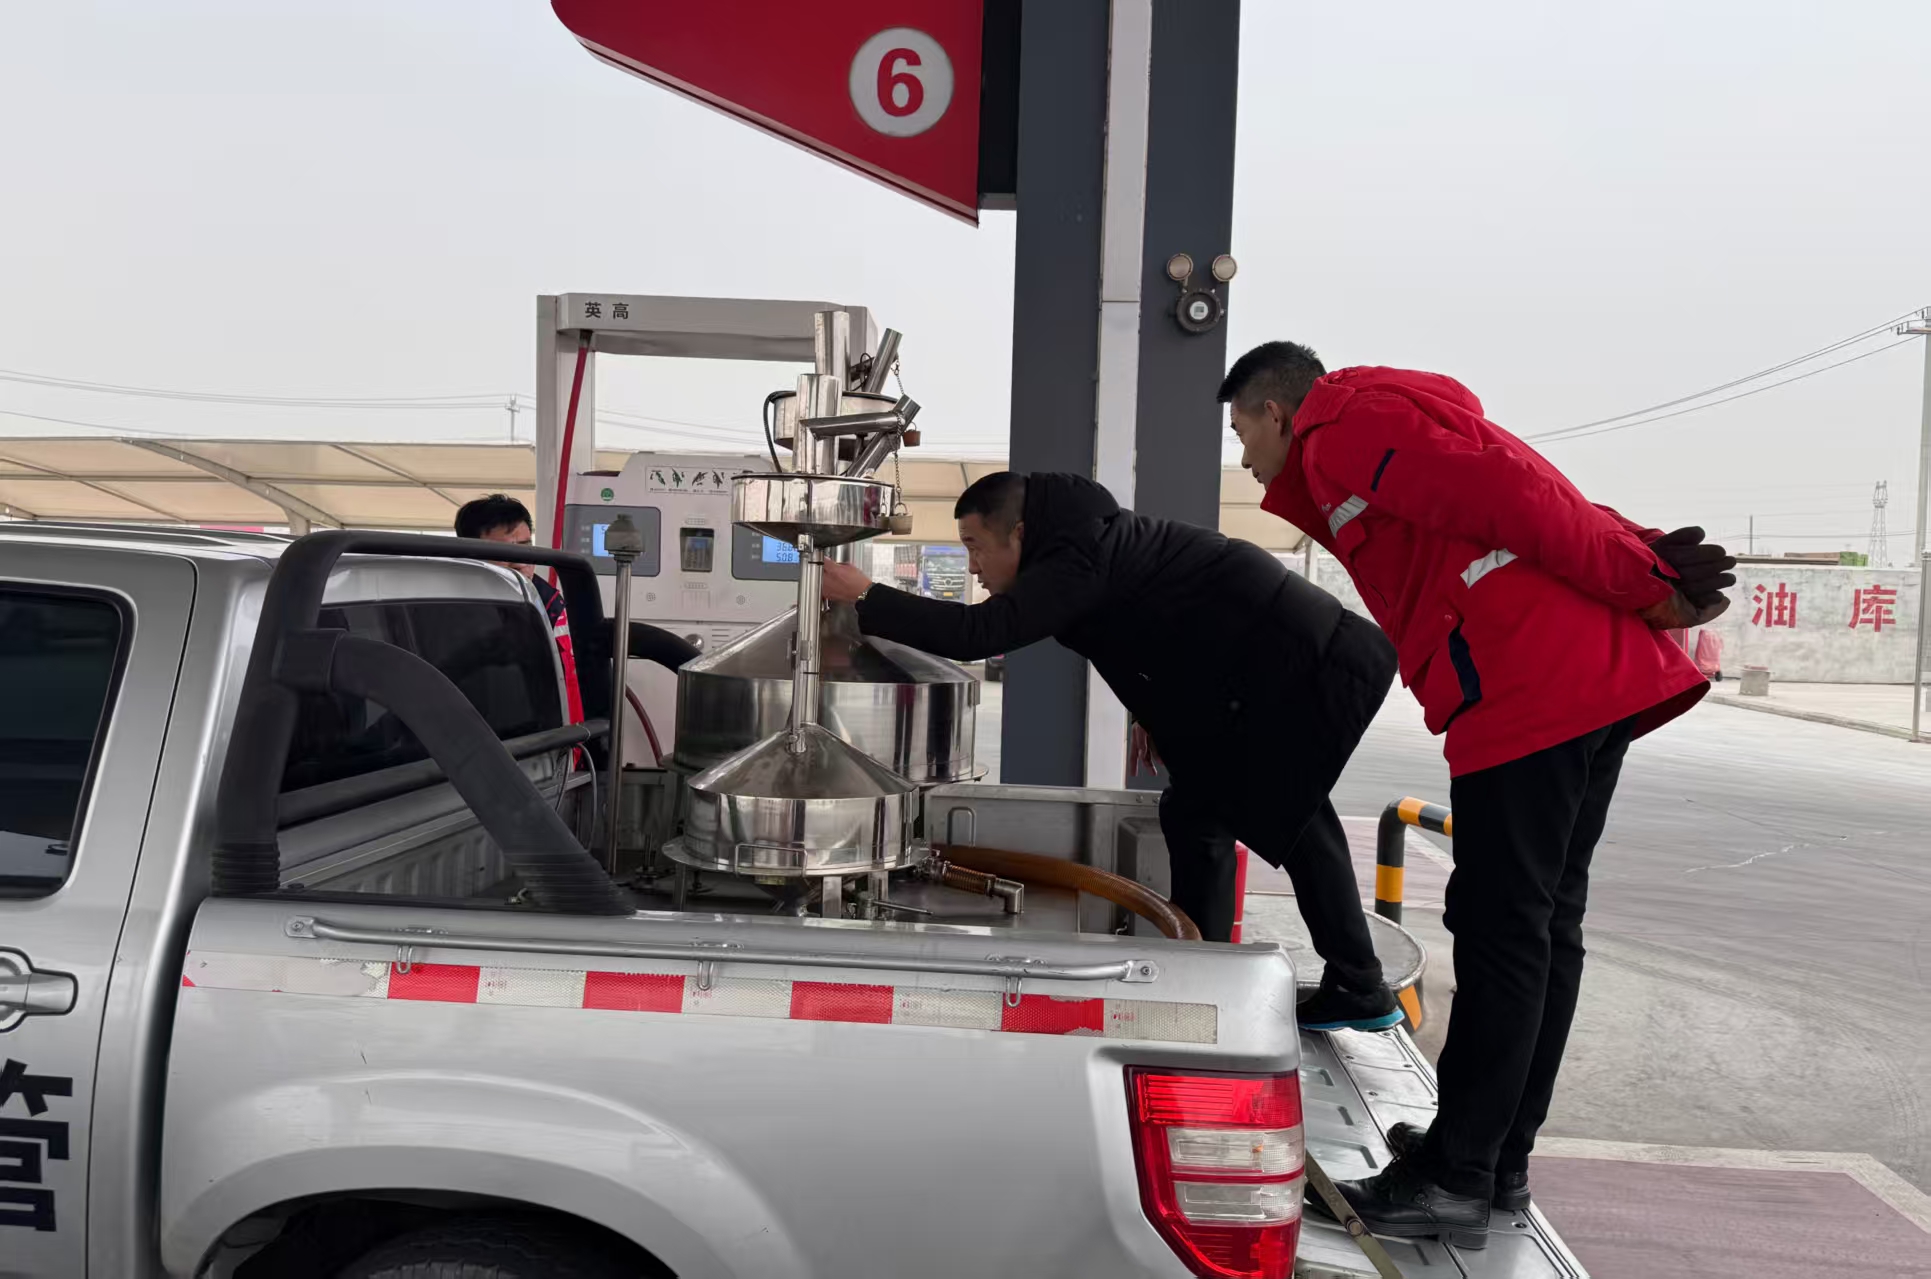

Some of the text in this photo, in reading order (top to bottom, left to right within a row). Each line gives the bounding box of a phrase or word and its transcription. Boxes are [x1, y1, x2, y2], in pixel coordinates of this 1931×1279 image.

[877, 47, 924, 117] 6
[584, 301, 629, 320] 英高
[1751, 582, 1897, 632] 油库
